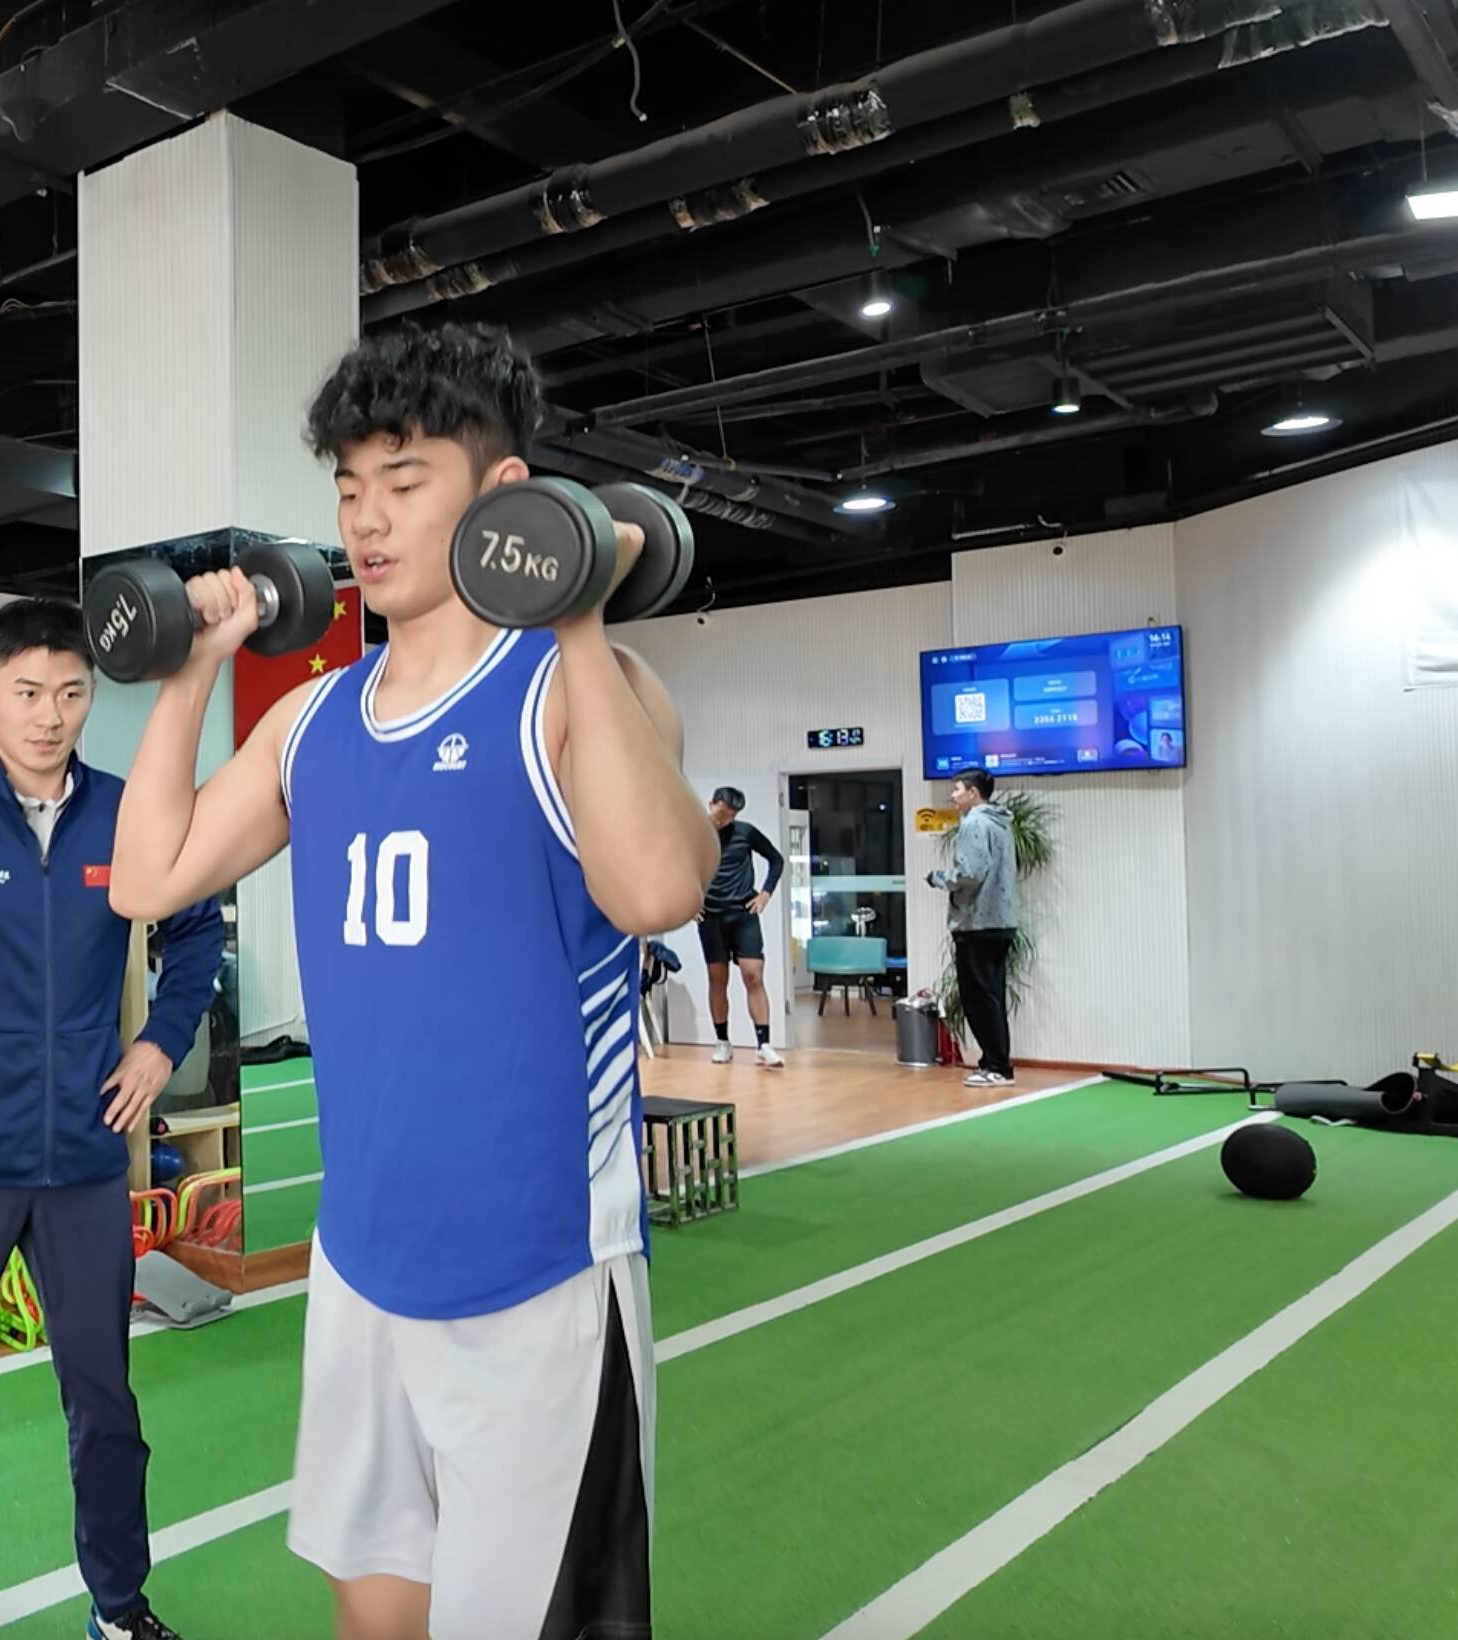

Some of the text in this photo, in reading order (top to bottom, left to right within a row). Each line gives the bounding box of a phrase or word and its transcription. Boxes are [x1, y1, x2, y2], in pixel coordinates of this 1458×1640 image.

[480, 529, 559, 582] 7.5KG
[99, 593, 138, 653] 7.5KG
[343, 829, 429, 947] 10
